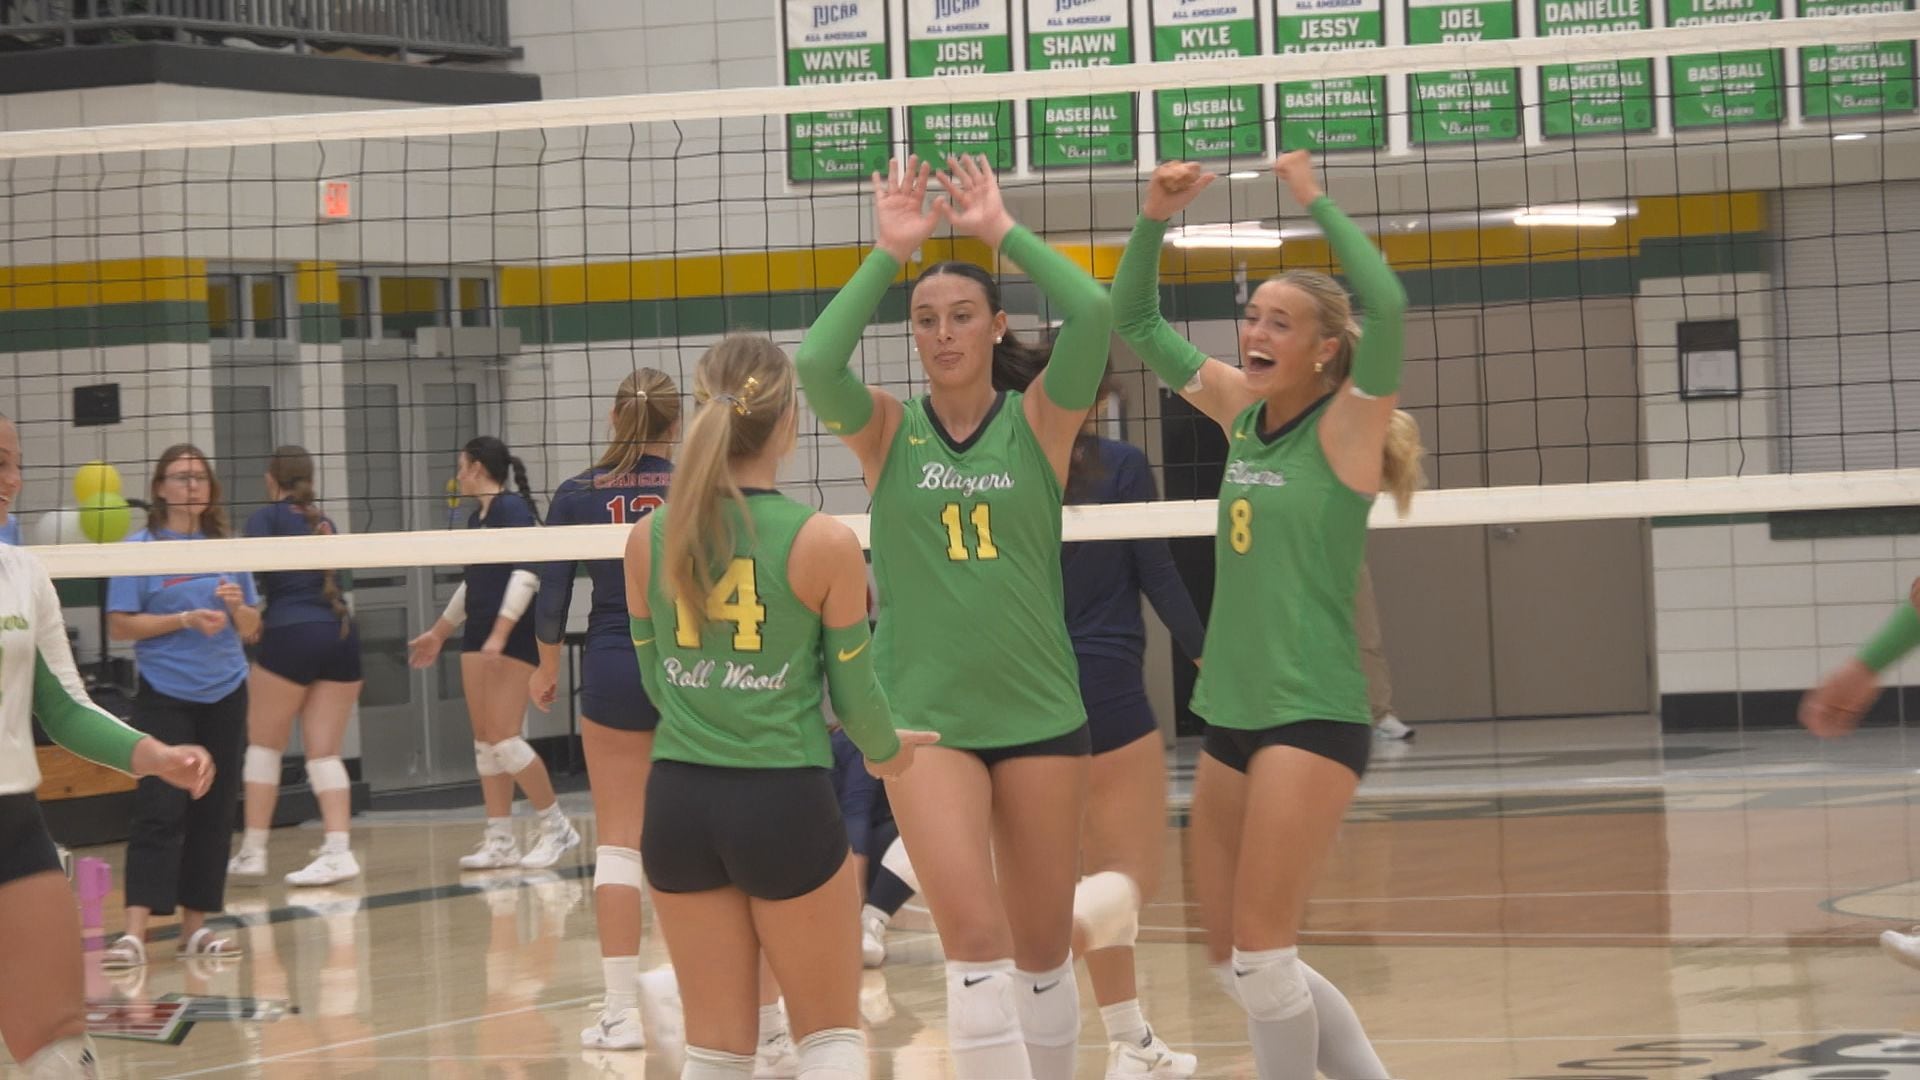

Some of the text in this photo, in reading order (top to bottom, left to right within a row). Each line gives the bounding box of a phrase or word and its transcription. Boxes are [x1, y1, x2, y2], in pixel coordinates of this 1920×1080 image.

[1439, 8, 1484, 30] JOEL
[1545, 0, 1640, 22] DANIELLE
[1181, 25, 1231, 48] KYLE
[1300, 17, 1360, 39] JESSY
[936, 41, 984, 62] JOSH
[1043, 33, 1116, 56] SHAWN
[802, 48, 872, 71] WAYNE
[1808, 52, 1906, 73] BASKETBALL
[1548, 71, 1643, 92] BASKETBALL
[1687, 63, 1764, 82] BASEBALL
[1285, 89, 1377, 108] BASKETBALL
[1416, 80, 1510, 100] BASKETBALL
[1045, 105, 1119, 124] BASEBALL
[1173, 97, 1246, 117] BASEBALL
[795, 120, 883, 139] BASKETBALL
[924, 113, 997, 130] BASEBALL
[916, 461, 1015, 498] Blazers
[939, 501, 1000, 561] 11
[1229, 497, 1252, 556] 8
[663, 656, 789, 690] Roll Wood
